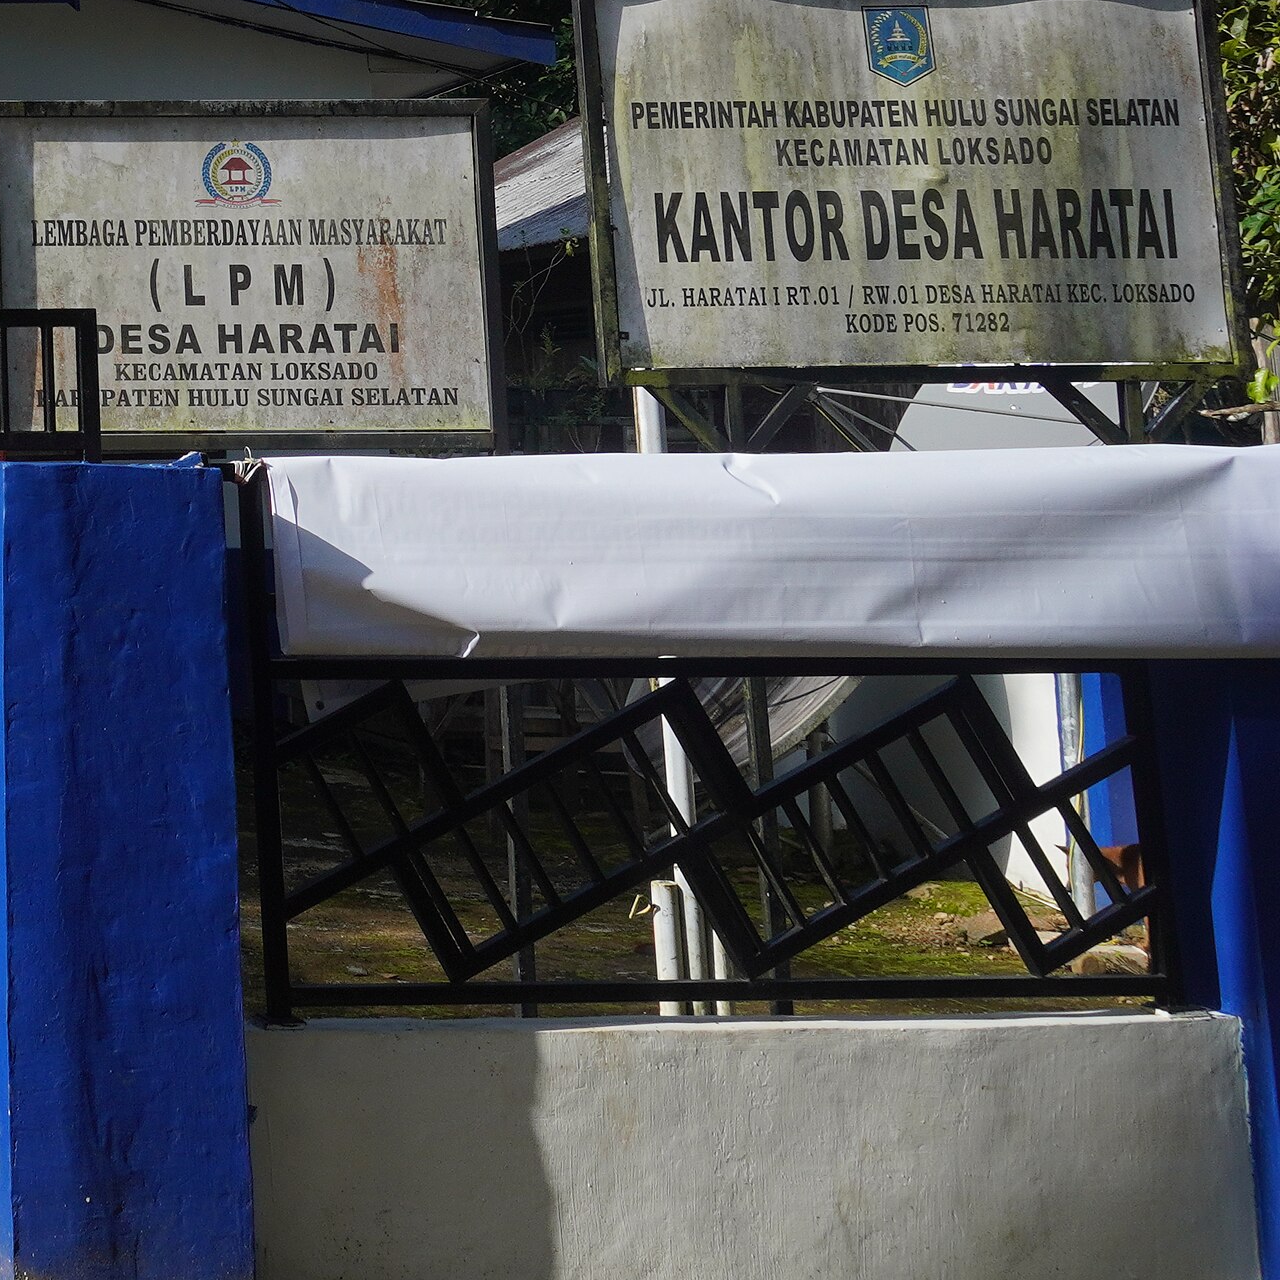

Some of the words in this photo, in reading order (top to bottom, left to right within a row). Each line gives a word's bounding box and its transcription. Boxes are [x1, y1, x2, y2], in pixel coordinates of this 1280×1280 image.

[631, 100, 777, 129] PEMERINTAH
[784, 99, 918, 129] KABUPATEN
[925, 99, 987, 127] HULU
[995, 98, 1079, 127] SUNGAI
[1086, 98, 1180, 127] SELATAN
[776, 138, 929, 167] KECAMATAN
[939, 137, 1053, 165] LOKSADO
[32, 220, 129, 247] LEMBAGA
[135, 220, 303, 246] PEMBERDAYAAN
[309, 218, 448, 246] MASYARAKAT
[654, 189, 850, 263] KANTOR
[862, 188, 983, 260] DESA
[994, 187, 1178, 260] HARATAI
[646, 287, 676, 307] JL.
[682, 286, 767, 306] HARATAI
[785, 285, 840, 306] RT.01
[863, 285, 918, 305] RW.01
[926, 284, 977, 304] DESA
[981, 283, 1062, 304] HARATAI
[1067, 282, 1107, 305] KEC.
[1112, 281, 1196, 303] LOKSADO
[845, 312, 897, 334] KODE
[903, 312, 946, 333] POS.
[951, 311, 1010, 333] 71282
[96, 324, 201, 355] DESA
[219, 323, 400, 354] HARATAI
[115, 363, 262, 381] KECAMATAN
[270, 361, 378, 381] LOKSADO
[187, 388, 248, 407] HULU
[258, 388, 344, 407] SUNGAI
[351, 387, 459, 406] SELATAN
